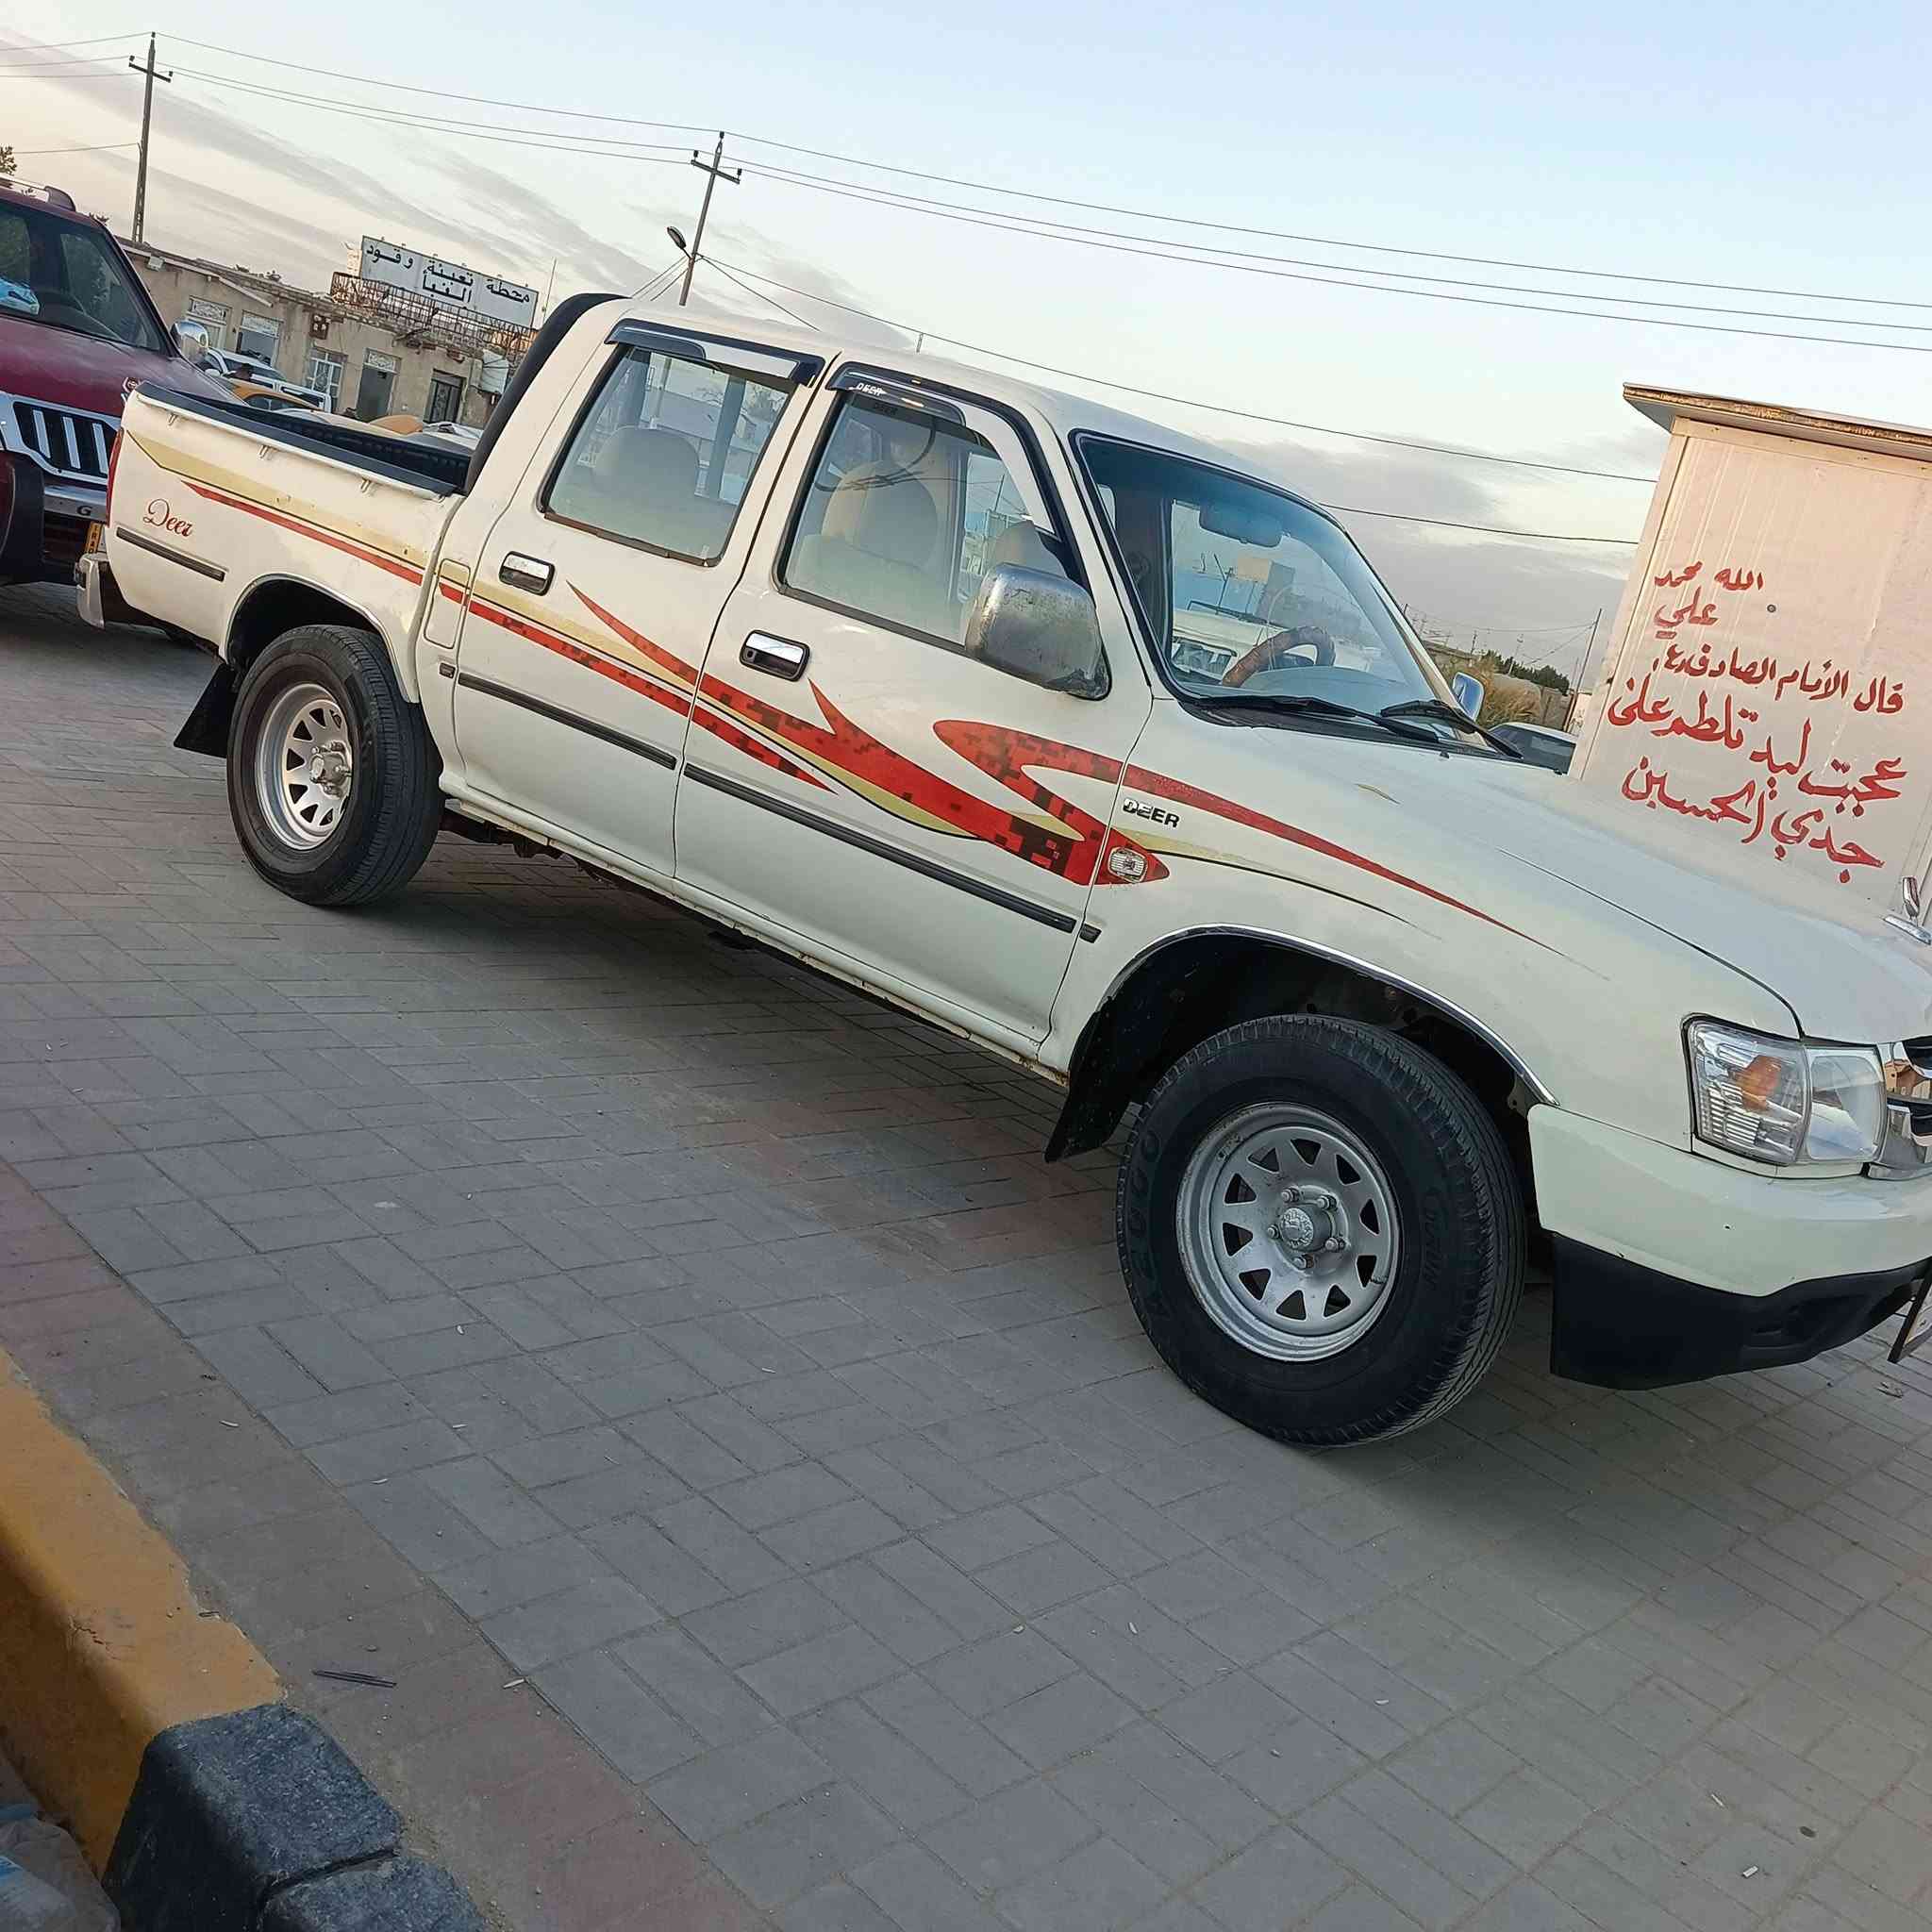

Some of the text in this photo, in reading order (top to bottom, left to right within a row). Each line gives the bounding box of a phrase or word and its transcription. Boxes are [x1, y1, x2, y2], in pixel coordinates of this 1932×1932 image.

[366, 243, 414, 269] وقود
[486, 277, 530, 304] محطة
[142, 498, 193, 537] Deer
[1654, 560, 1764, 591] الله محمد
[1653, 585, 1719, 641] علي
[1853, 676, 1904, 714] قال
[1123, 798, 1180, 828] DEER
[1621, 756, 1886, 885] جدي الحسين
